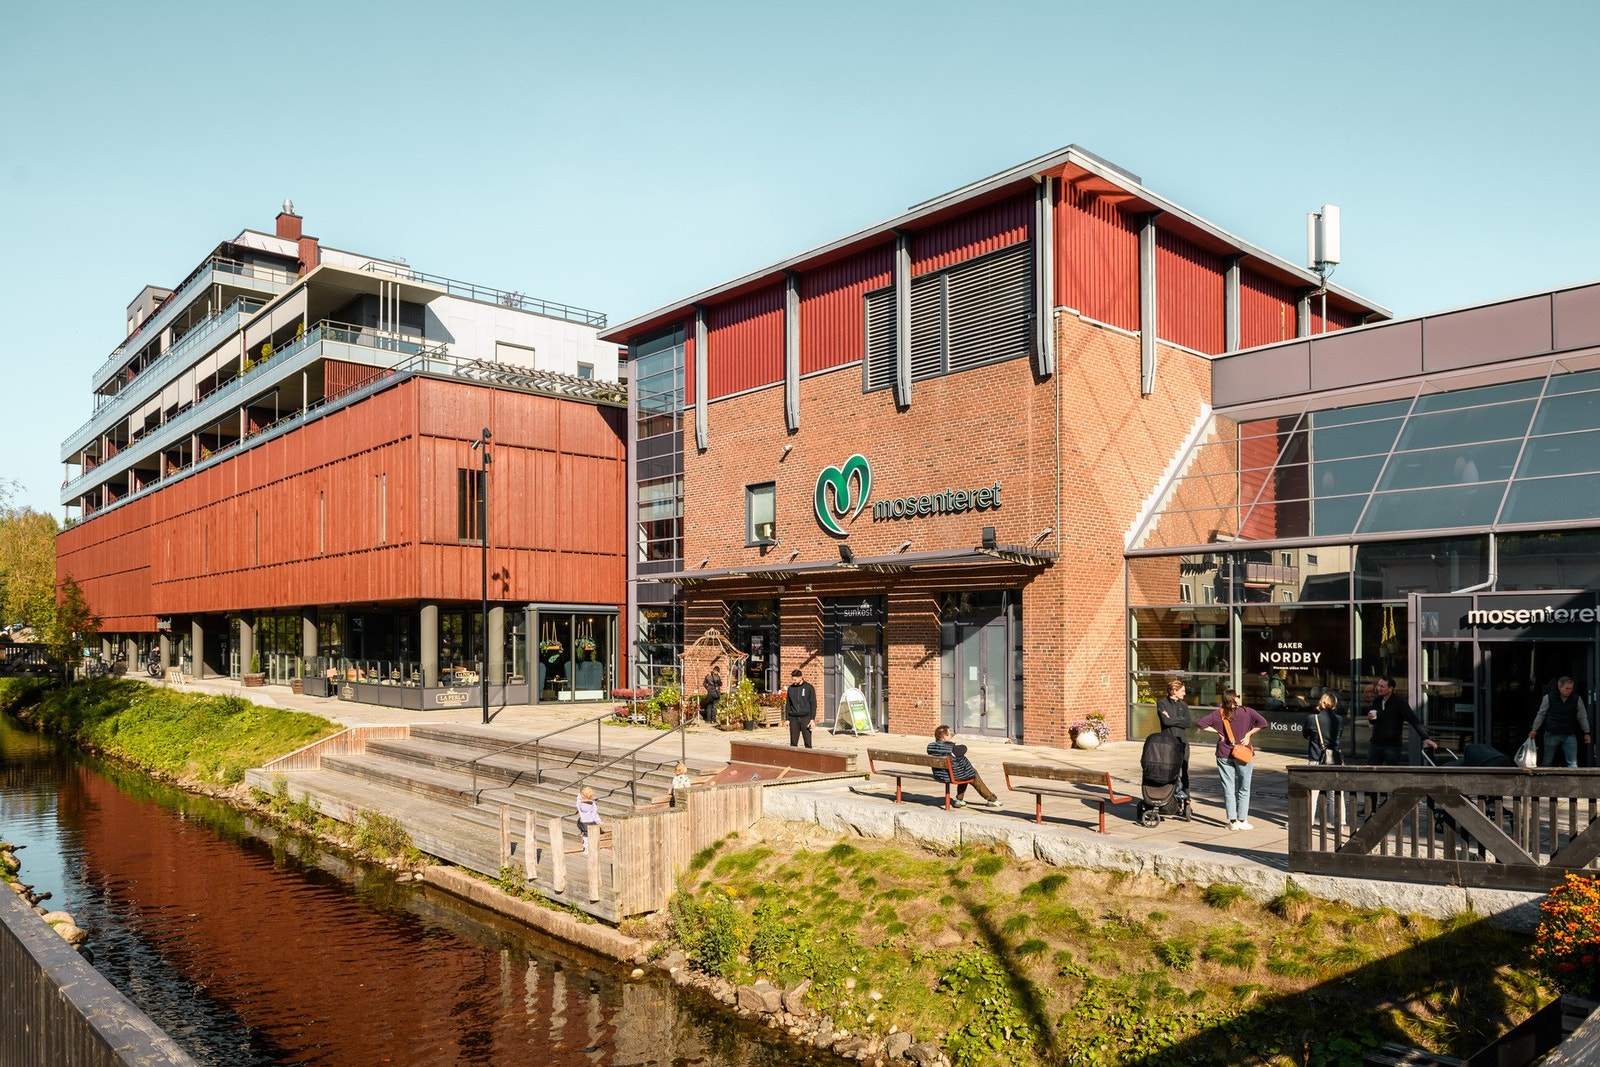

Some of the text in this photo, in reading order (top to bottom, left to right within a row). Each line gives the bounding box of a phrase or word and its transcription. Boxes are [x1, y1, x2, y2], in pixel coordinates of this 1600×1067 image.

[874, 482, 1002, 519] mosenteret
[843, 607, 873, 617] sunkost
[1468, 605, 1600, 624] mosenteret
[1260, 651, 1321, 663] NORDBY
[1270, 721, 1288, 731] Kos
